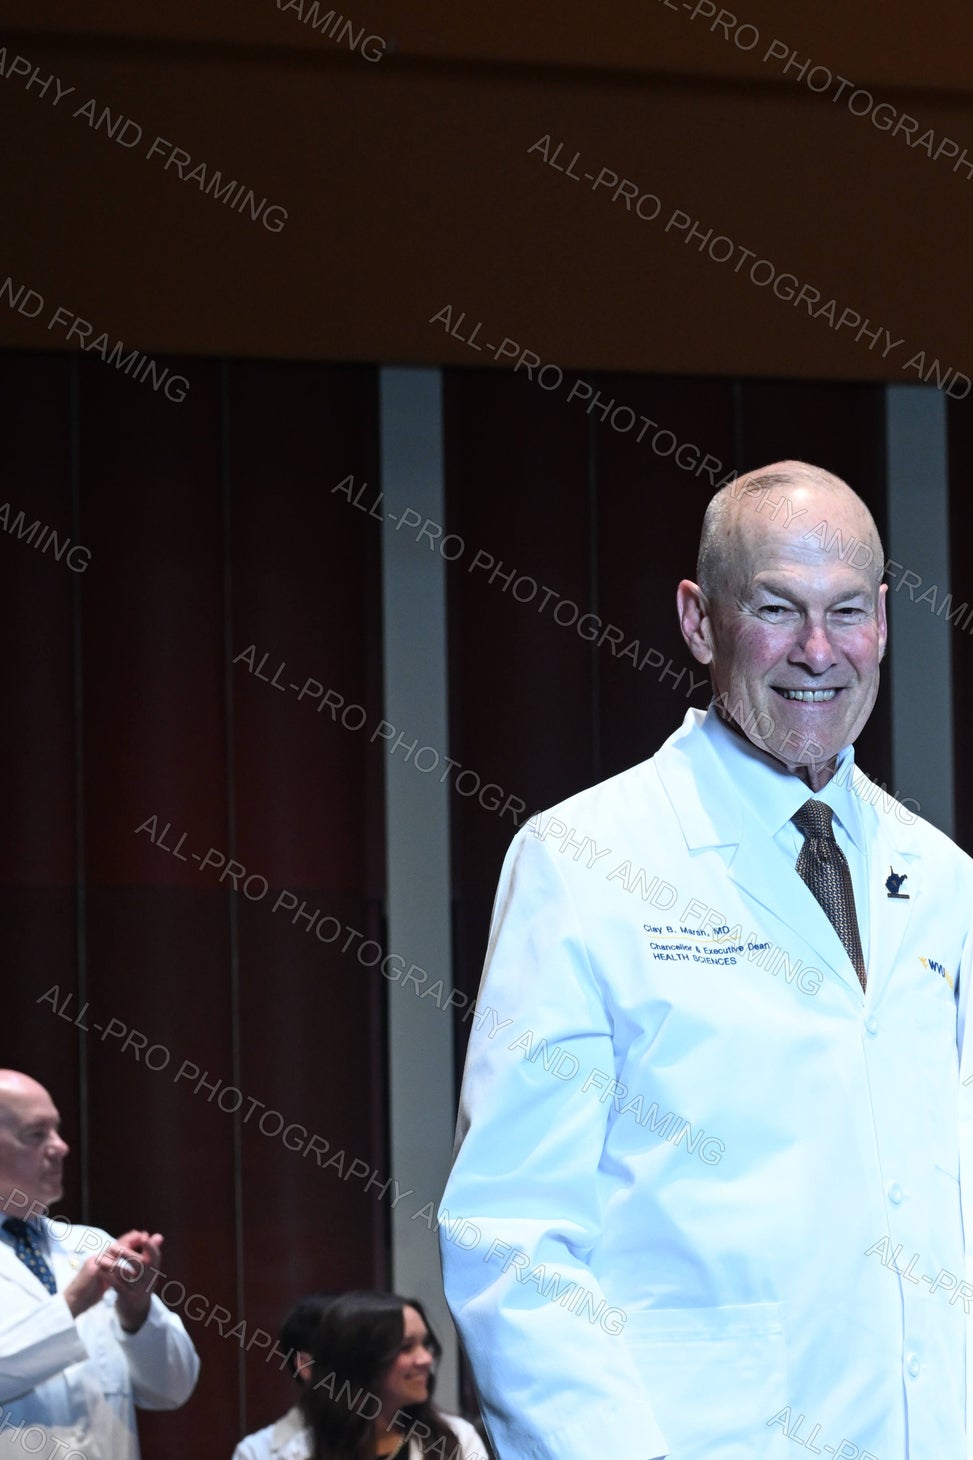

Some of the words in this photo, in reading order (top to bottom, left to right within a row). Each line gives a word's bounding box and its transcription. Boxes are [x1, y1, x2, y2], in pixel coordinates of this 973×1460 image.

[644, 924, 662, 935] Clay
[666, 925, 677, 934] B.
[713, 925, 730, 935] MD
[650, 942, 692, 951] Chancellor
[703, 944, 744, 955] Executive
[747, 942, 771, 951] Dean
[653, 953, 690, 961] HEALTH
[692, 954, 737, 966] SCIENCES
